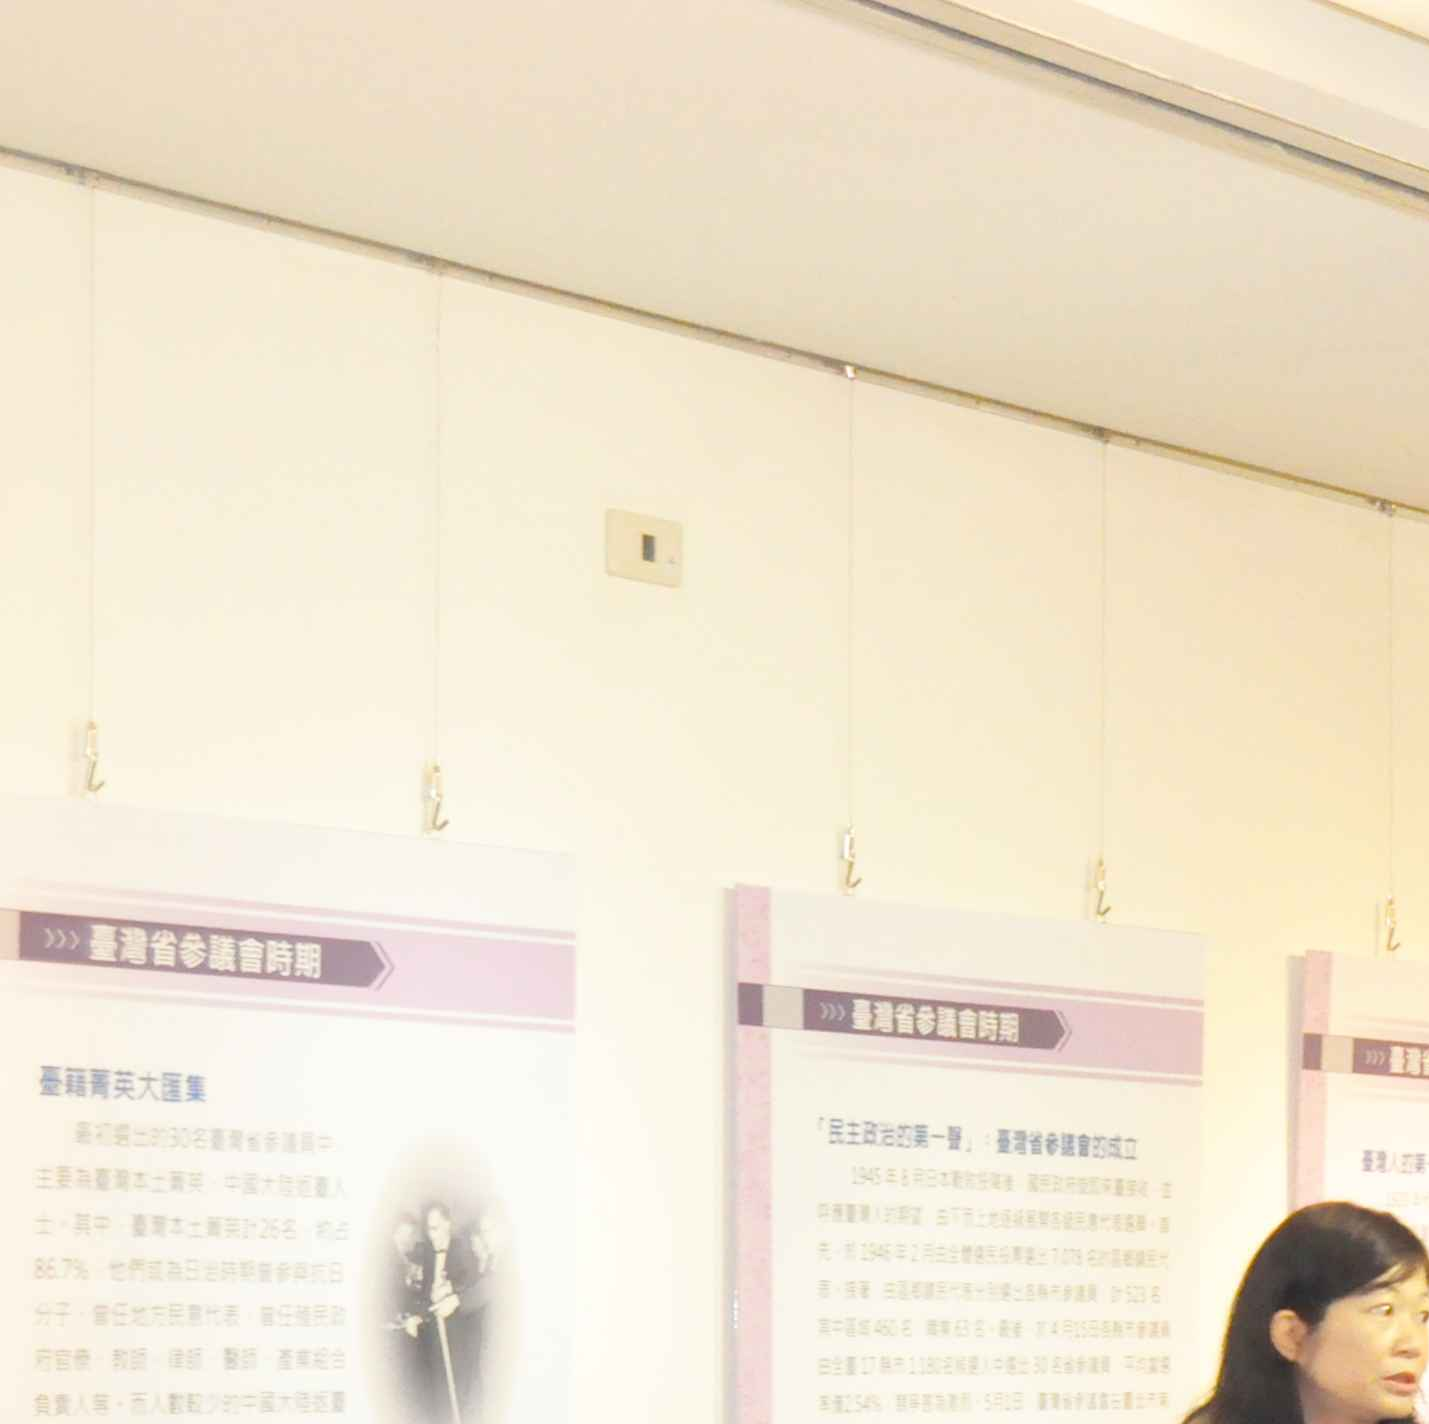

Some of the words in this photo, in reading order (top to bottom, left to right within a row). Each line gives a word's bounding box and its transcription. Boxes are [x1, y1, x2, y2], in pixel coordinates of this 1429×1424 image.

[88, 924, 322, 979] 臺灣省參議會時期
[851, 999, 1020, 1044] 臺灣省參議會時期
